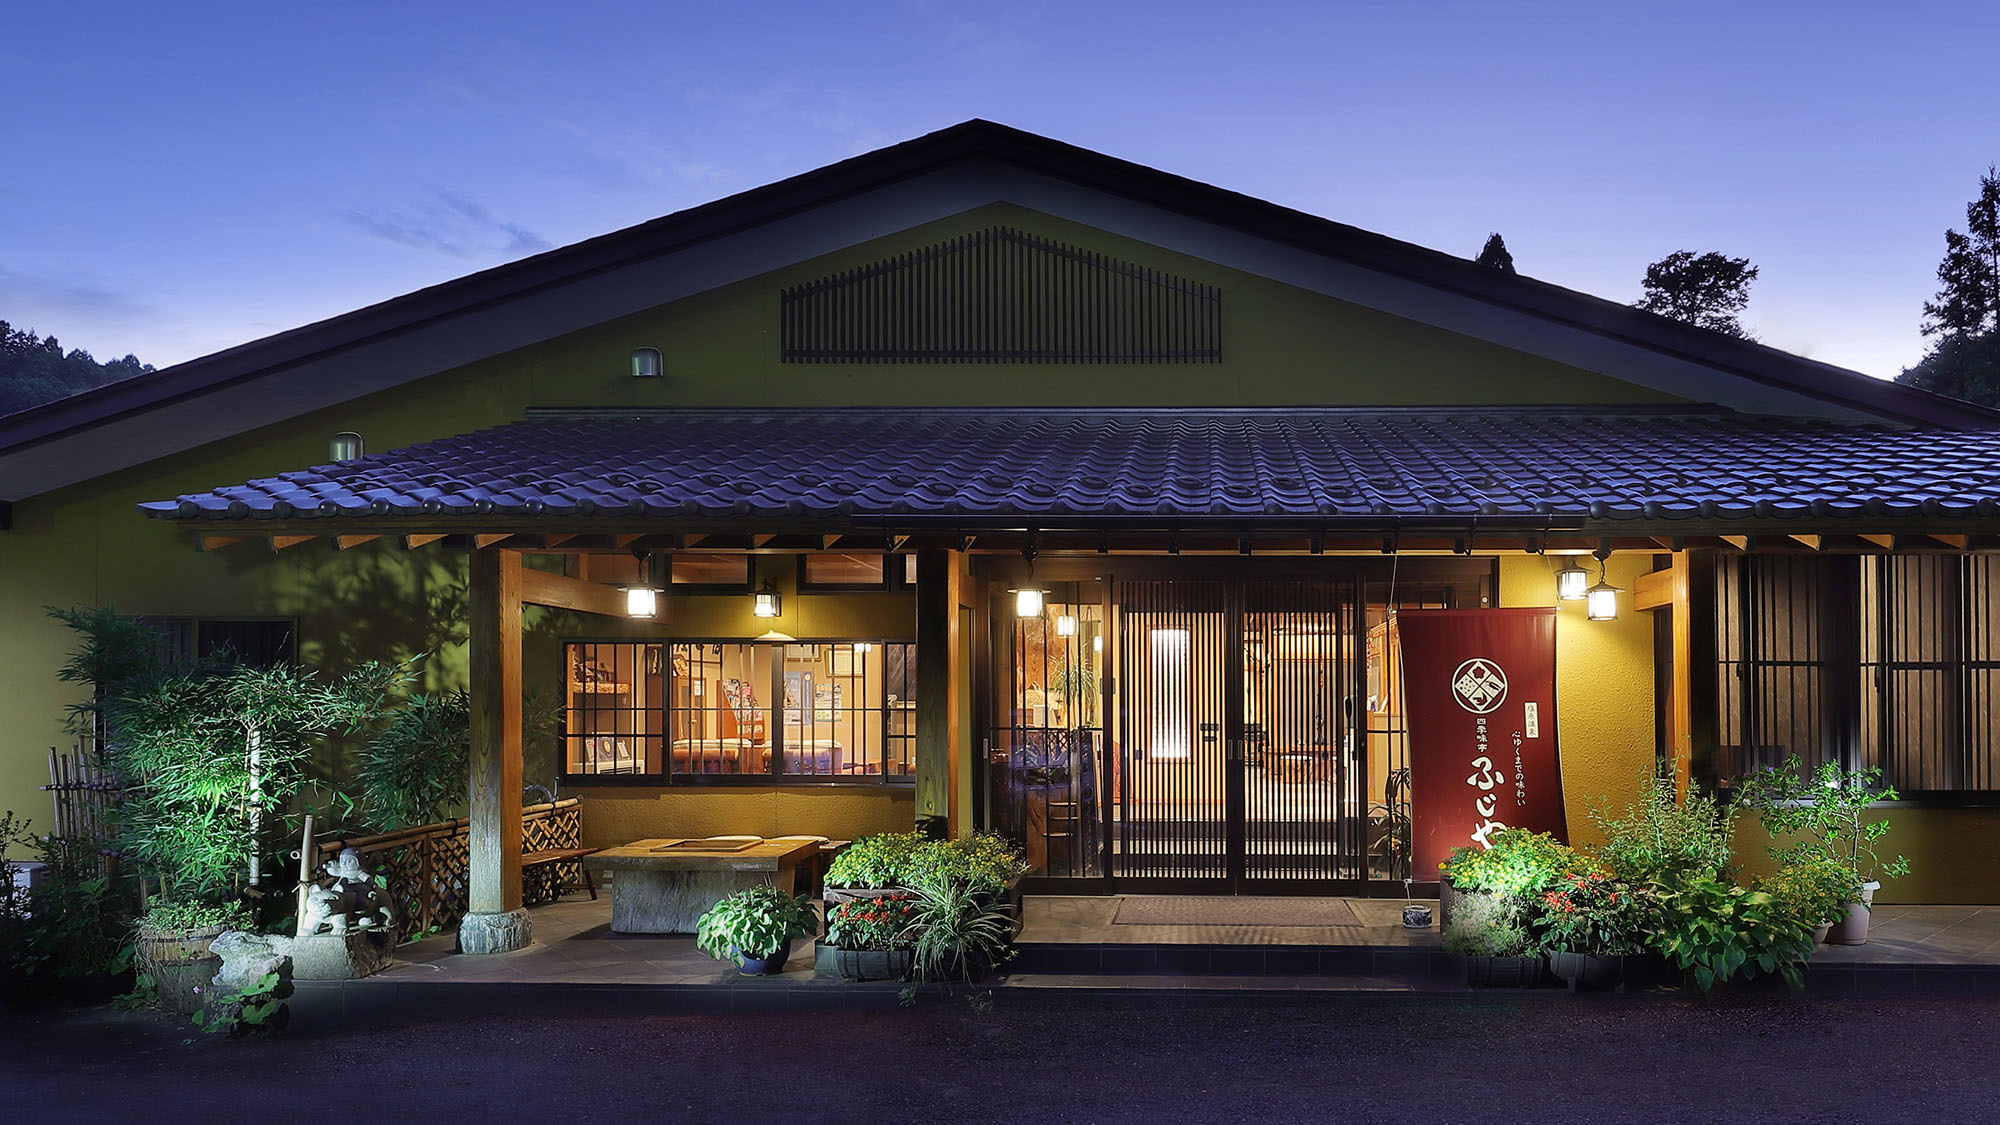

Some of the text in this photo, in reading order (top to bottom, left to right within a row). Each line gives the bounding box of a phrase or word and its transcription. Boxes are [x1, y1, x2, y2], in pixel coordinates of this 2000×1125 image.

[1477, 718, 1487, 752] 四季味亭
[1512, 731, 1525, 806] 心ゆくまでの味わい
